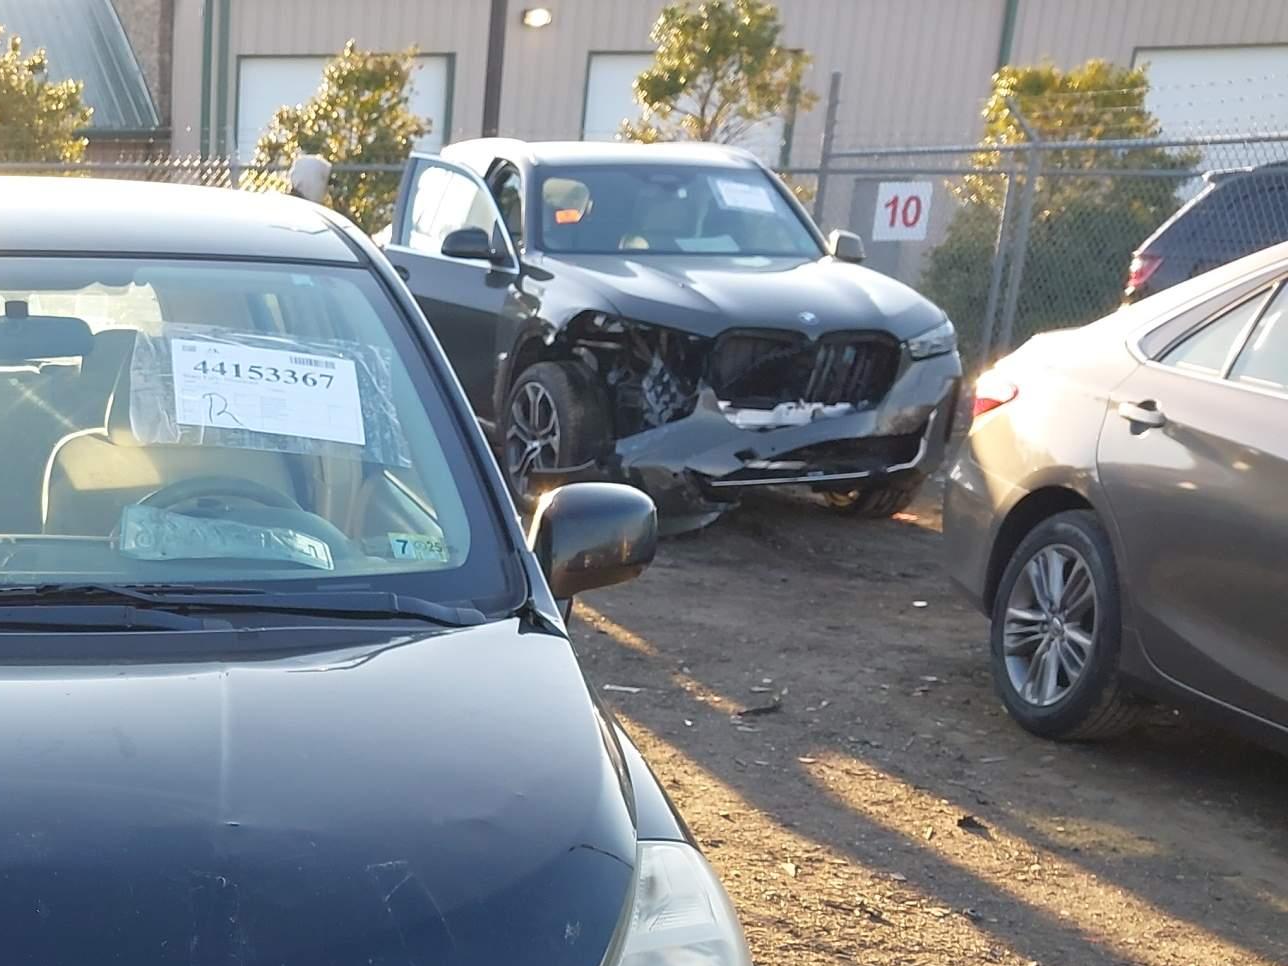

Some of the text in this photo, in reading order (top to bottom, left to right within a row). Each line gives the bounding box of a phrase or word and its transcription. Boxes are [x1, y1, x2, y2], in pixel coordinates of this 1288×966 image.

[885, 195, 921, 228] 10
[193, 360, 335, 389] 44153367
[395, 539, 408, 554] 7
